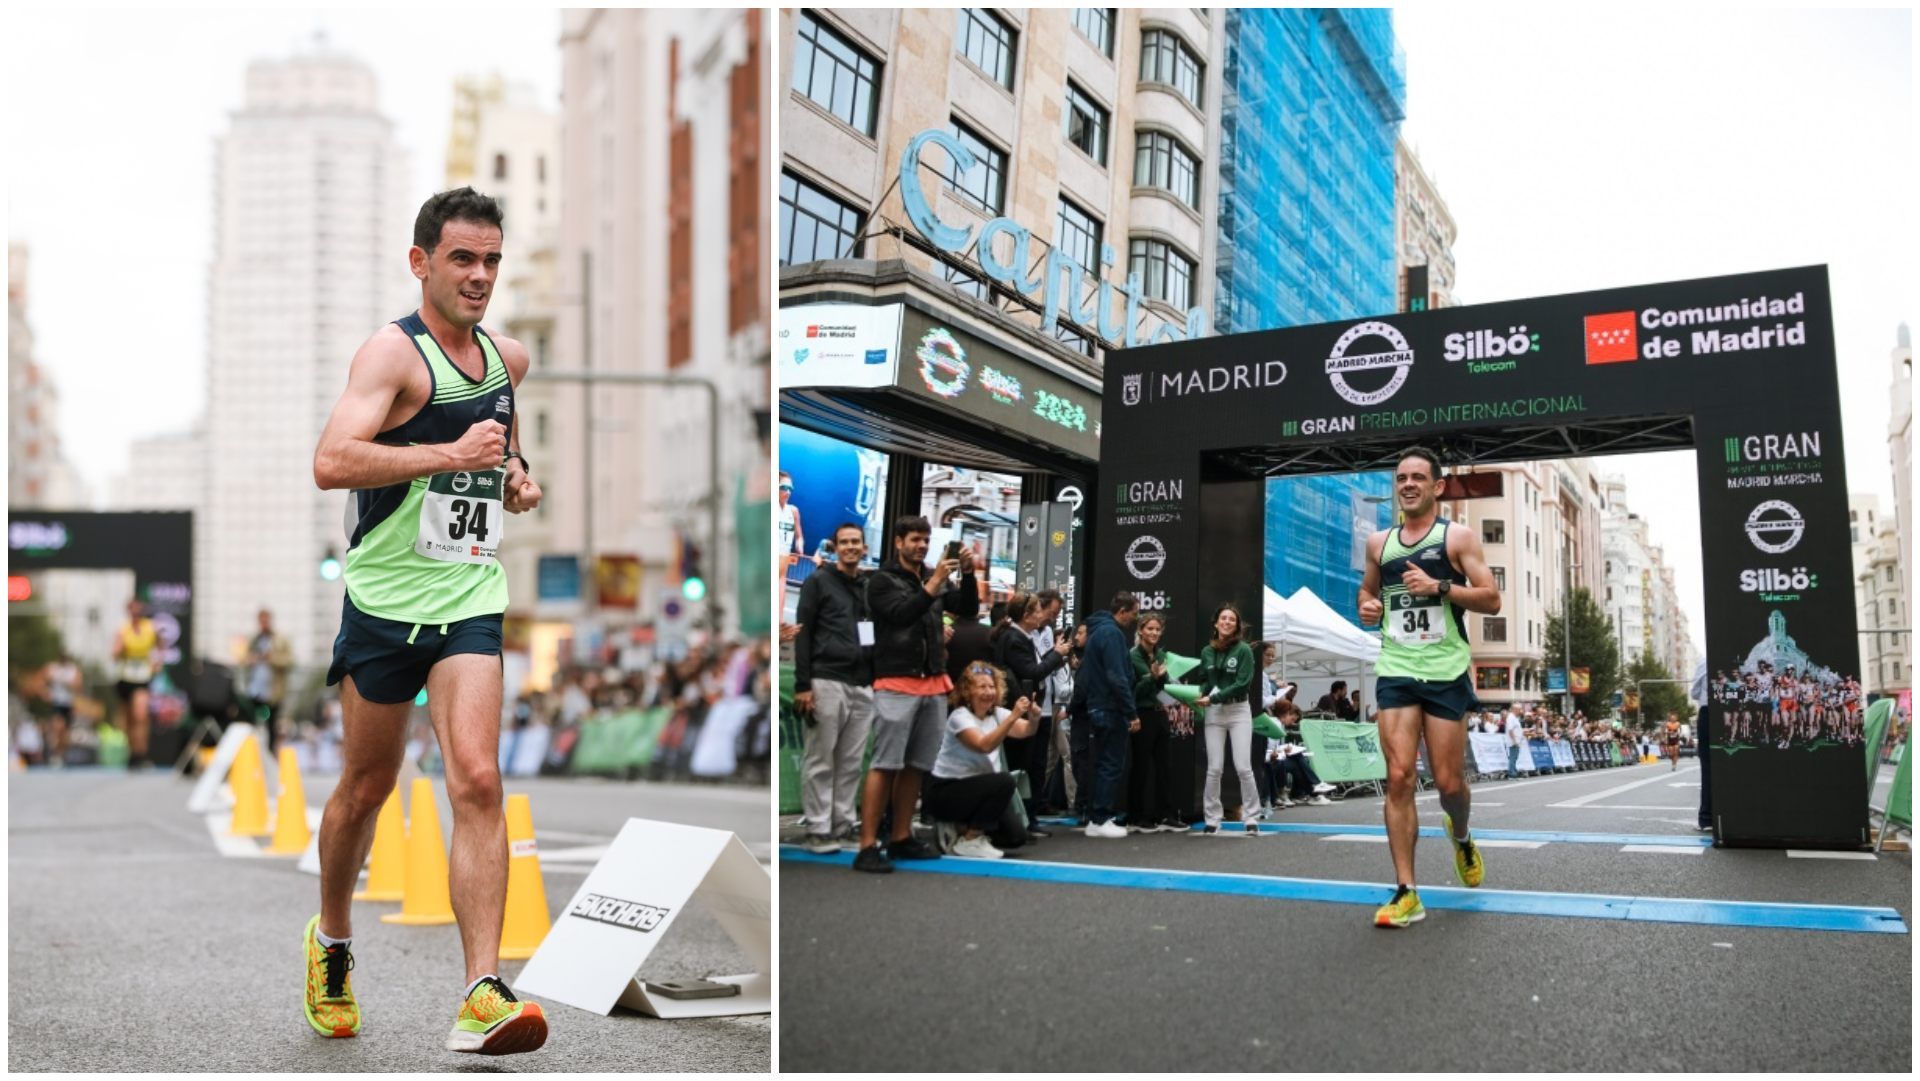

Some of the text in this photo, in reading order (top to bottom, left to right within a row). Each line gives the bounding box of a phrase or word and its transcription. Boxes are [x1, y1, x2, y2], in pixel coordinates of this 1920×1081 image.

[1641, 292, 1804, 329] Comunidad
[1642, 322, 1805, 359] de Madrid
[1328, 353, 1411, 369] MADRID MARCHA
[1467, 361, 1516, 374] Telecom
[1161, 361, 1287, 398] MADRID
[1301, 415, 1355, 435] GRAN
[1361, 409, 1427, 429] PREMIO
[1434, 395, 1587, 423] INTERNACIONAL
[1744, 431, 1821, 461] GRAN
[1130, 479, 1182, 503] GRAN
[1727, 472, 1823, 488] MADRID MARCHA
[448, 499, 488, 542] 34
[436, 544, 463, 553] MADRID
[1403, 609, 1430, 633] 34
[570, 893, 671, 933] SKECHERS
